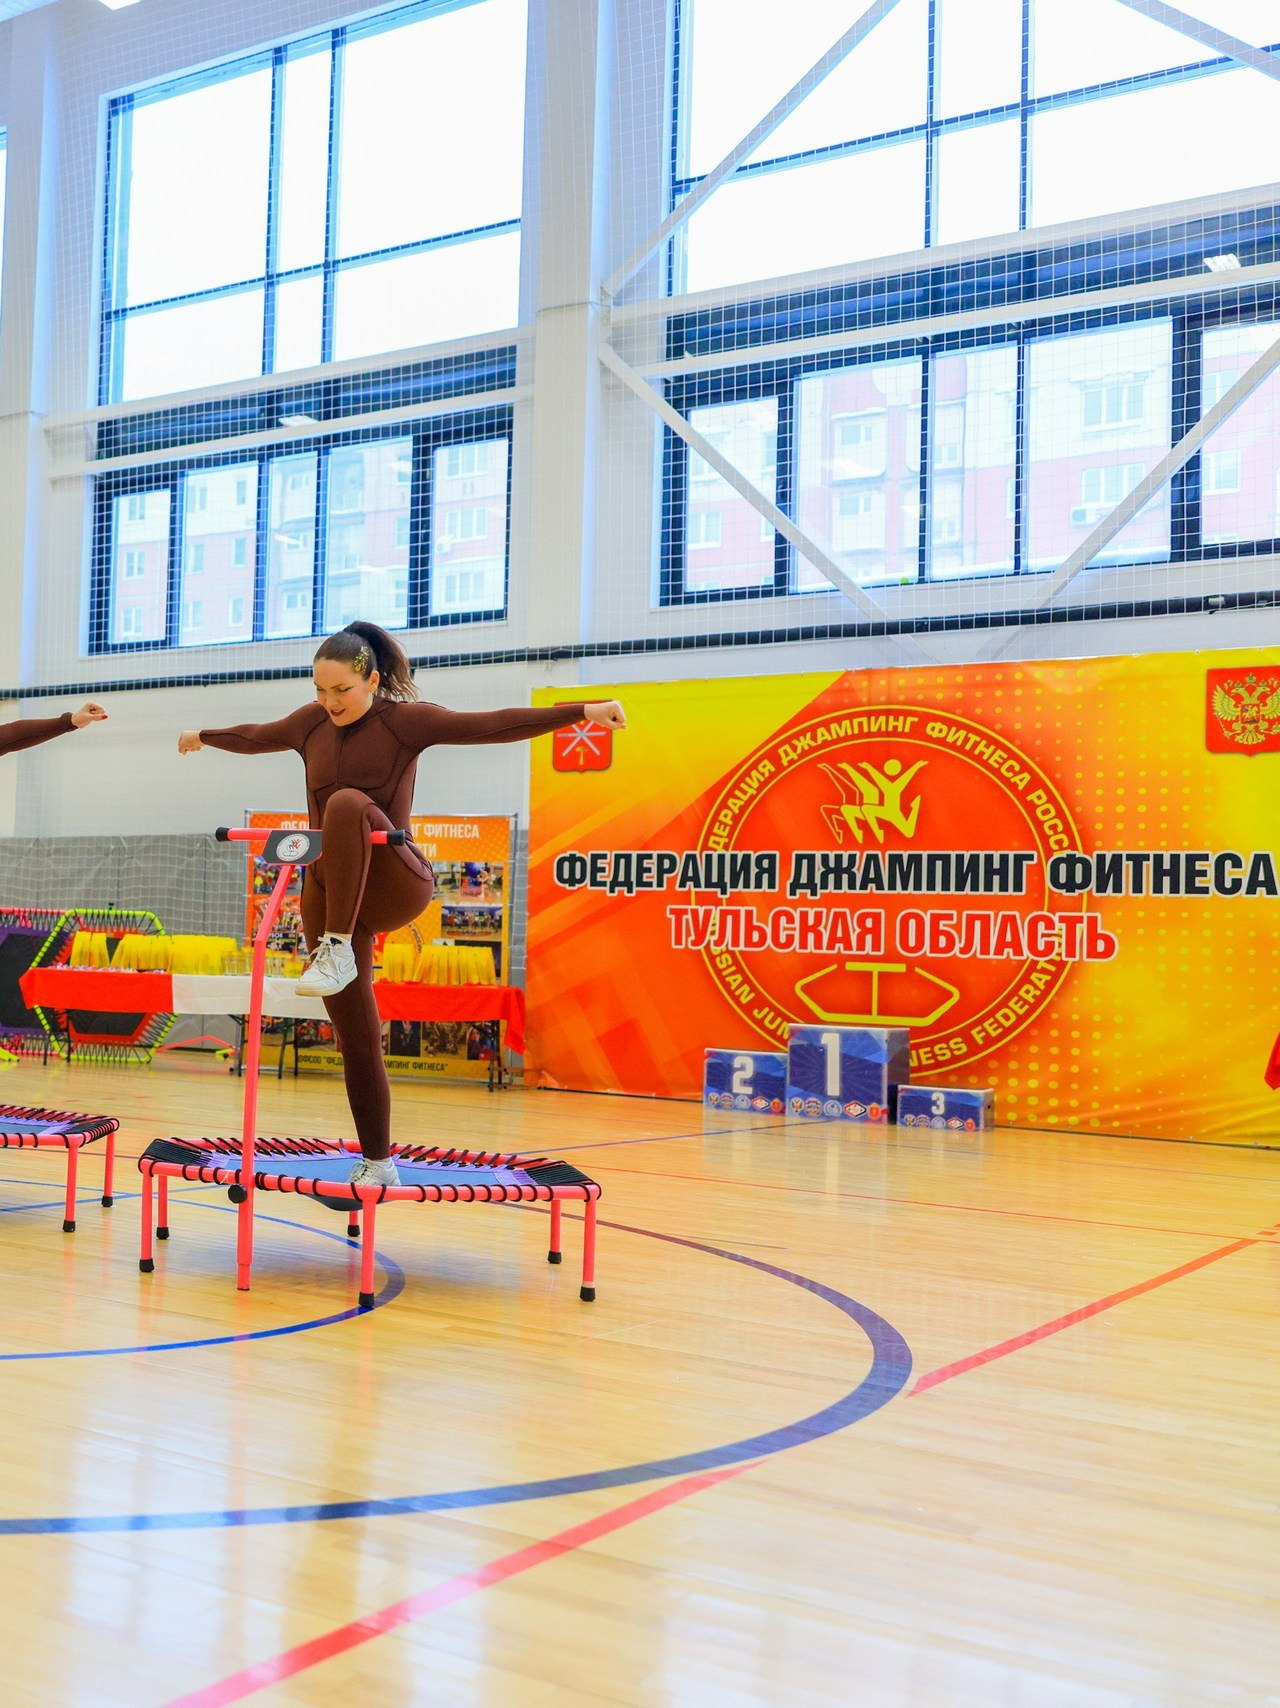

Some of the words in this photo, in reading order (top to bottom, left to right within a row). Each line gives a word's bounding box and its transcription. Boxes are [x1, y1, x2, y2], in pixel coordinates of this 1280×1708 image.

[707, 758, 776, 852] ДЕРАЦИЯ
[778, 715, 918, 765] ДЖАМПИНГ
[925, 720, 1032, 791] ФИТНЕСА
[1026, 788, 1072, 856] РОСС
[423, 823, 480, 839] ФИТНЕСА
[555, 851, 779, 896] ФЕДЕРАЦИЯ
[788, 851, 1037, 898] ДЖАМПИНГ
[1048, 851, 1279, 897] ФИТНЕСА
[667, 906, 885, 955] ТУЛЬСКАЯ
[897, 909, 1118, 962] ОБЛАСТЬ
[910, 1036, 968, 1068] NESS
[970, 945, 1061, 1046] FEDERAT
[383, 1059, 410, 1069] АМПИНГ
[732, 1056, 754, 1095] 2
[821, 1033, 841, 1096] 1
[931, 1092, 946, 1116] 3
